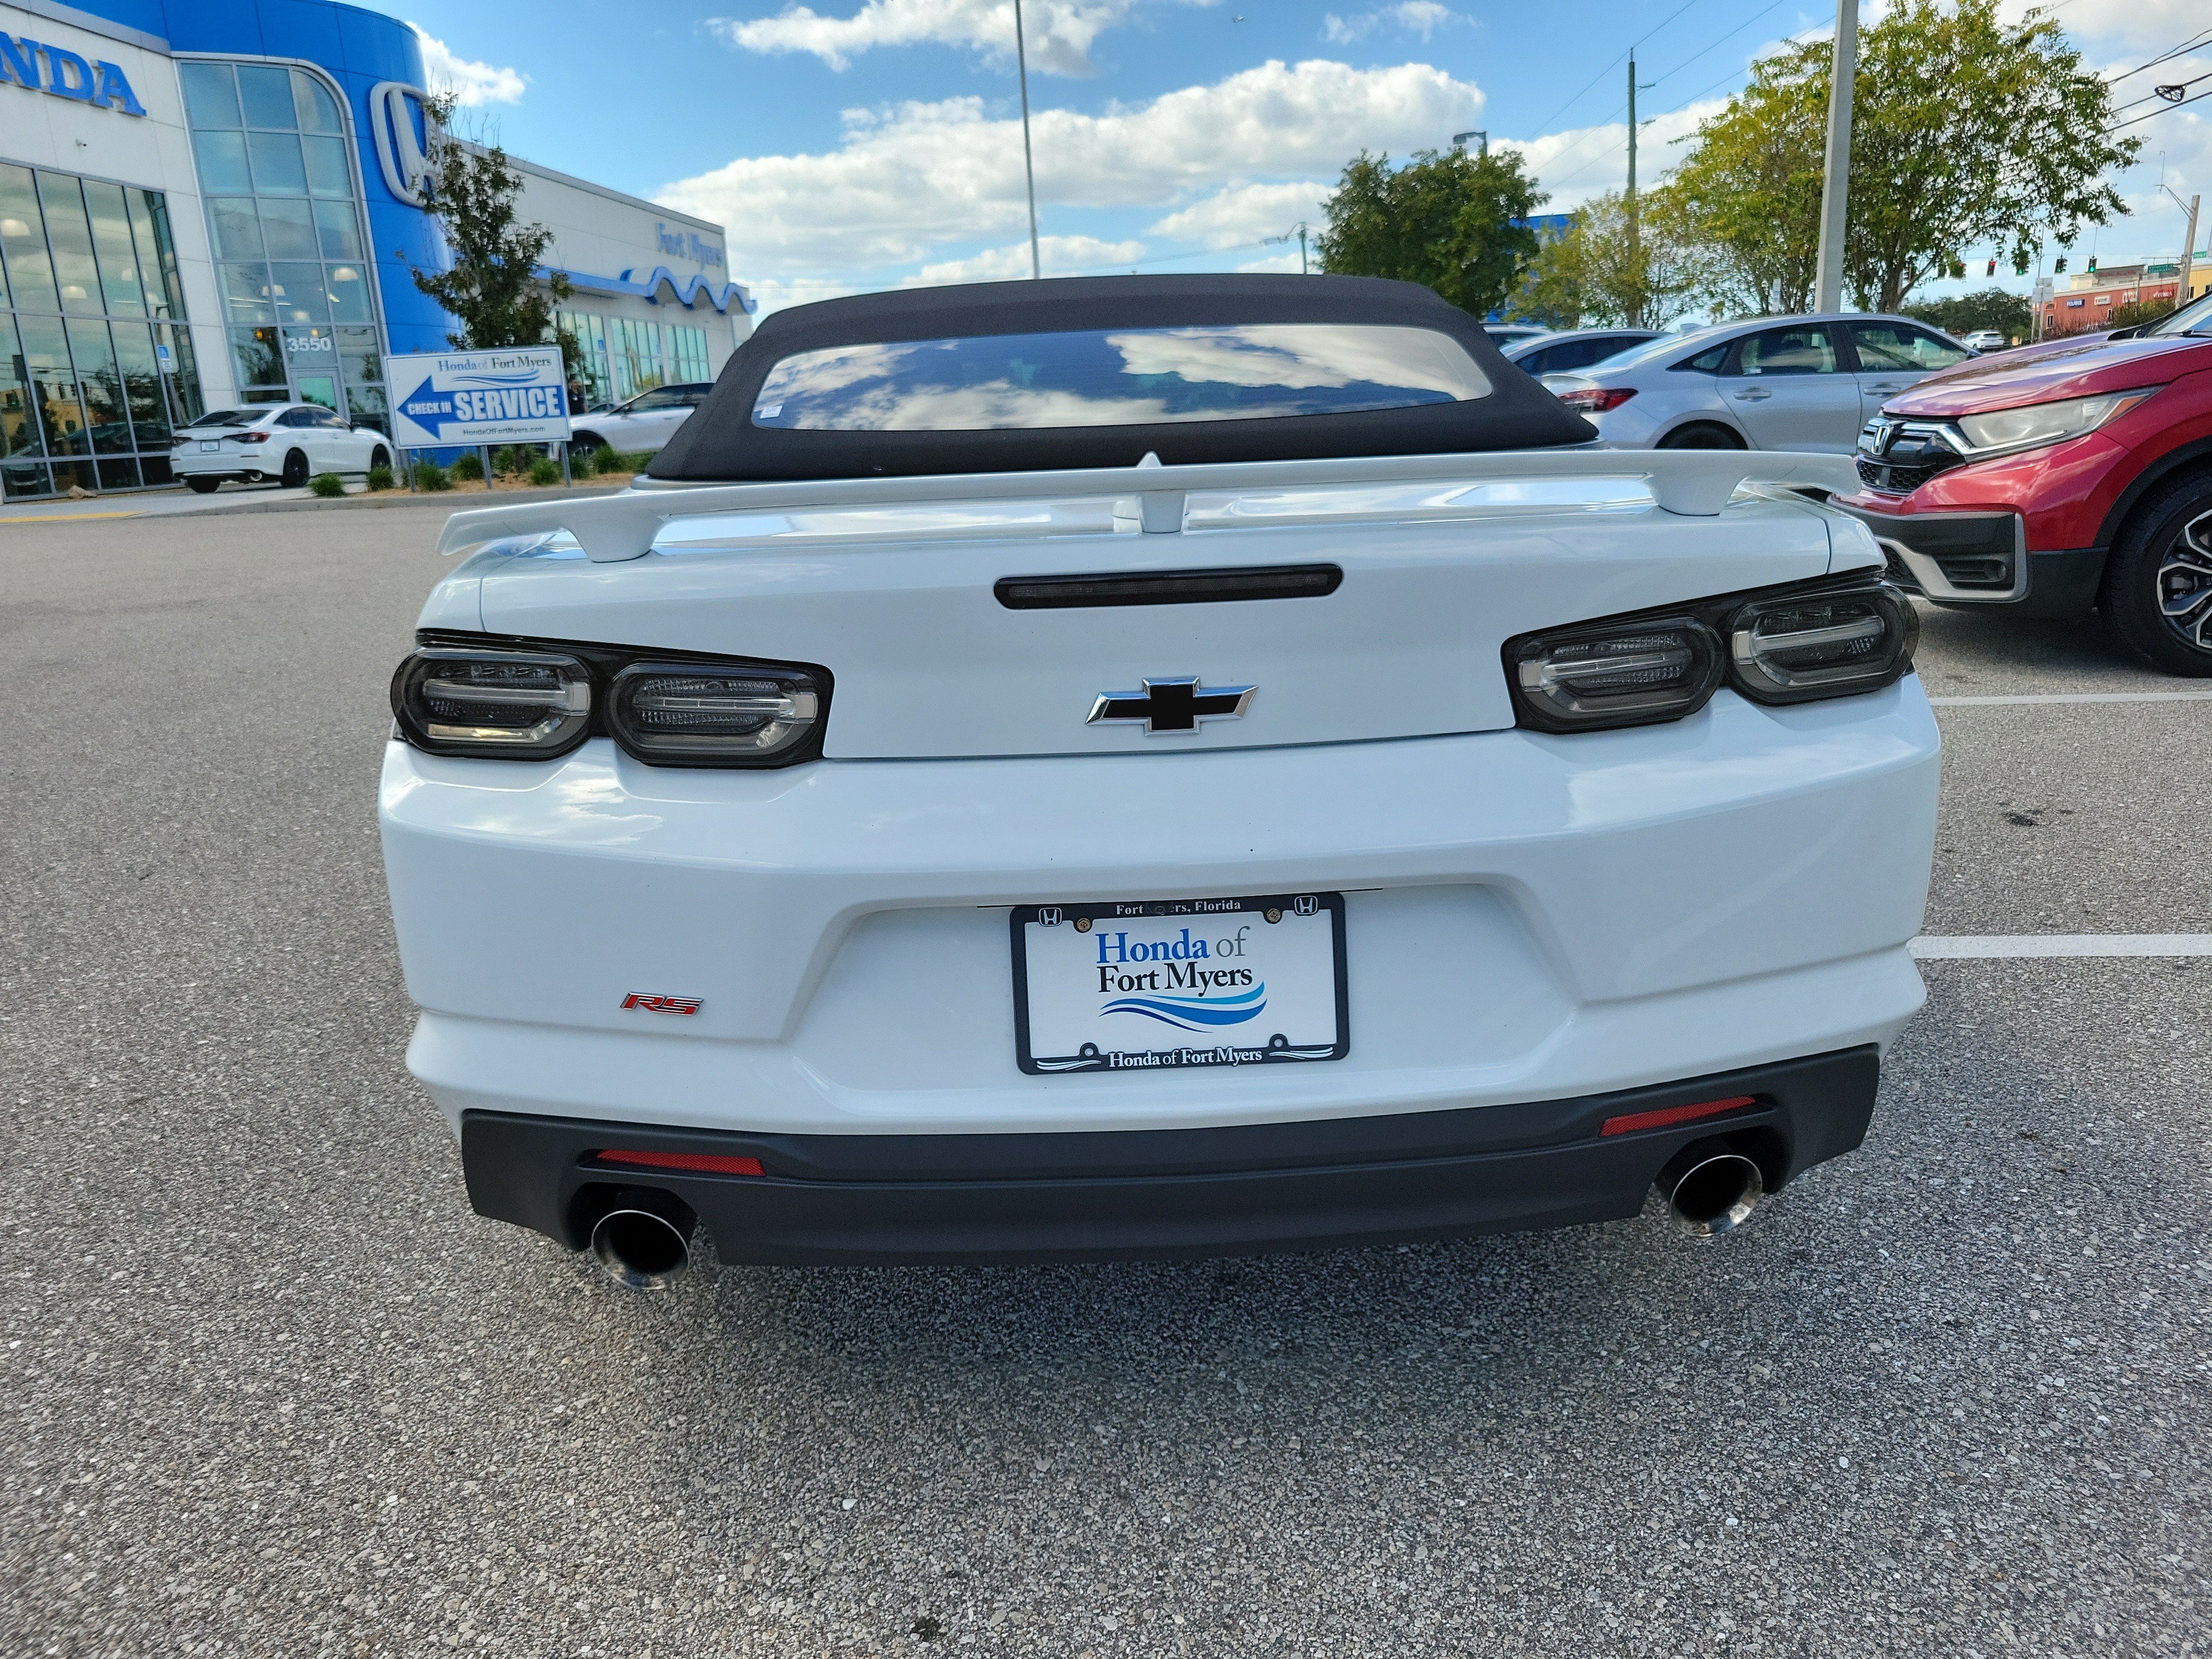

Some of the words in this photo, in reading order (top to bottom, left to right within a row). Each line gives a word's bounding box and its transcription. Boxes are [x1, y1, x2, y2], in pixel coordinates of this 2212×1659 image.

[287, 337, 332, 352] 3550
[438, 360, 477, 373] Honda
[477, 358, 489, 370] of
[492, 357, 516, 370] Fort
[516, 356, 552, 372] Myers
[408, 402, 439, 415] CHECK
[440, 401, 452, 413] IN
[453, 386, 561, 422] SERVICE
[463, 425, 546, 436] HondaOfFortMyers.com
[1116, 905, 1143, 915] Fort
[1195, 900, 1241, 911] Florida
[1095, 928, 1210, 963] Honda
[1216, 926, 1250, 958] of
[1098, 964, 1160, 993] Fort
[1164, 961, 1252, 997] Myers
[620, 991, 704, 1016] RS
[1108, 1051, 1163, 1069] Honda
[1163, 1050, 1180, 1066] of
[1181, 1048, 1215, 1065] Fort
[1215, 1046, 1262, 1066] Myers
